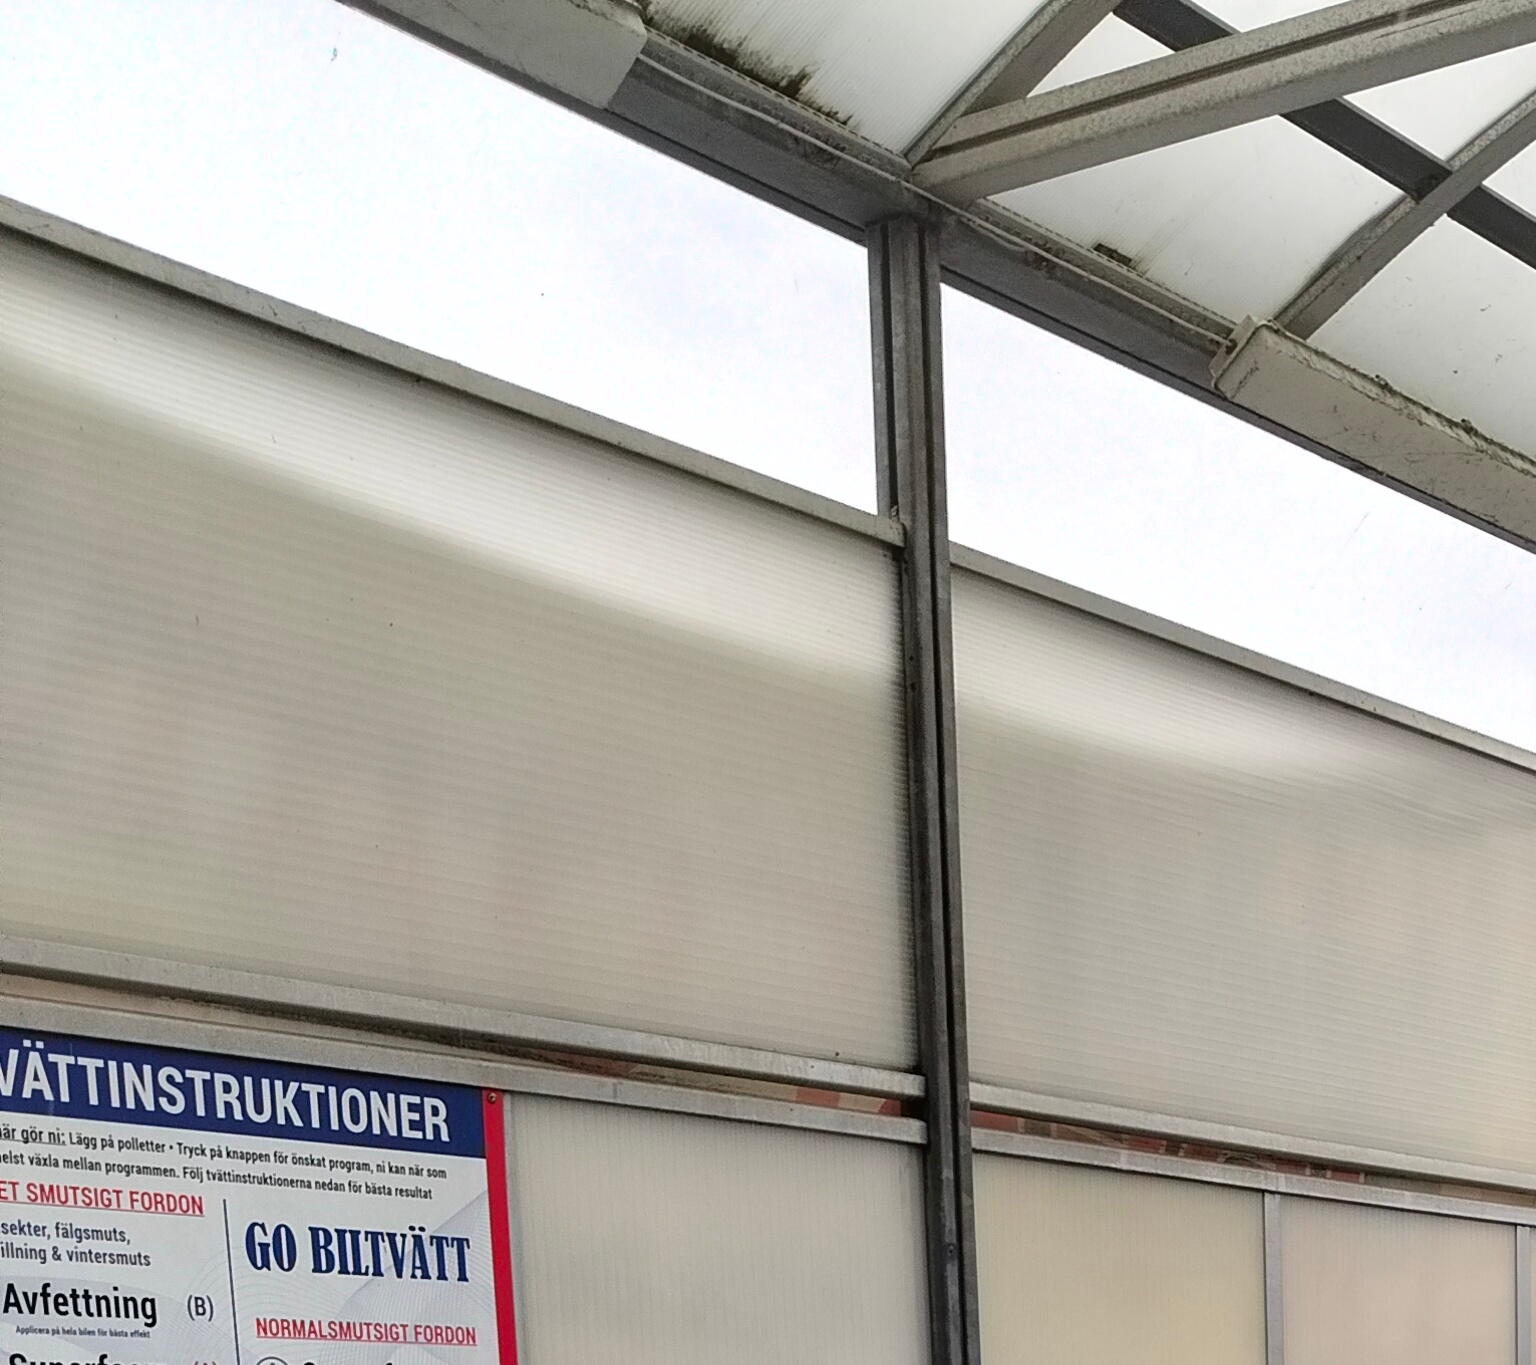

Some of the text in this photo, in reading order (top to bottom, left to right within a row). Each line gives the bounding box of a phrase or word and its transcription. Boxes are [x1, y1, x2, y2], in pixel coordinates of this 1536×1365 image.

[0, 1123, 447, 1180] är gör ni: Lägg på polletter Tryck på knappen för önskat program, ni kan när som
[0, 1150, 432, 1200] elst växla mellan programmen. Följ tvättinstruktionerna nedan för bästa resultat
[26, 1182, 123, 1209] SMUTSIGT
[129, 1190, 204, 1215] FORDON
[55, 1222, 130, 1245] fälgsmuts,
[52, 1246, 62, 1261] &
[66, 1249, 151, 1266] vintersmuts
[245, 1221, 471, 1282] GO BILTVÄTT
[3, 1283, 157, 1327] Avfettning
[187, 1294, 214, 1321] (B)
[16, 1326, 49, 1336] Applicera
[61, 1326, 77, 1336] hela
[256, 1318, 476, 1345] NORMALSMUTSIGT FORDON
